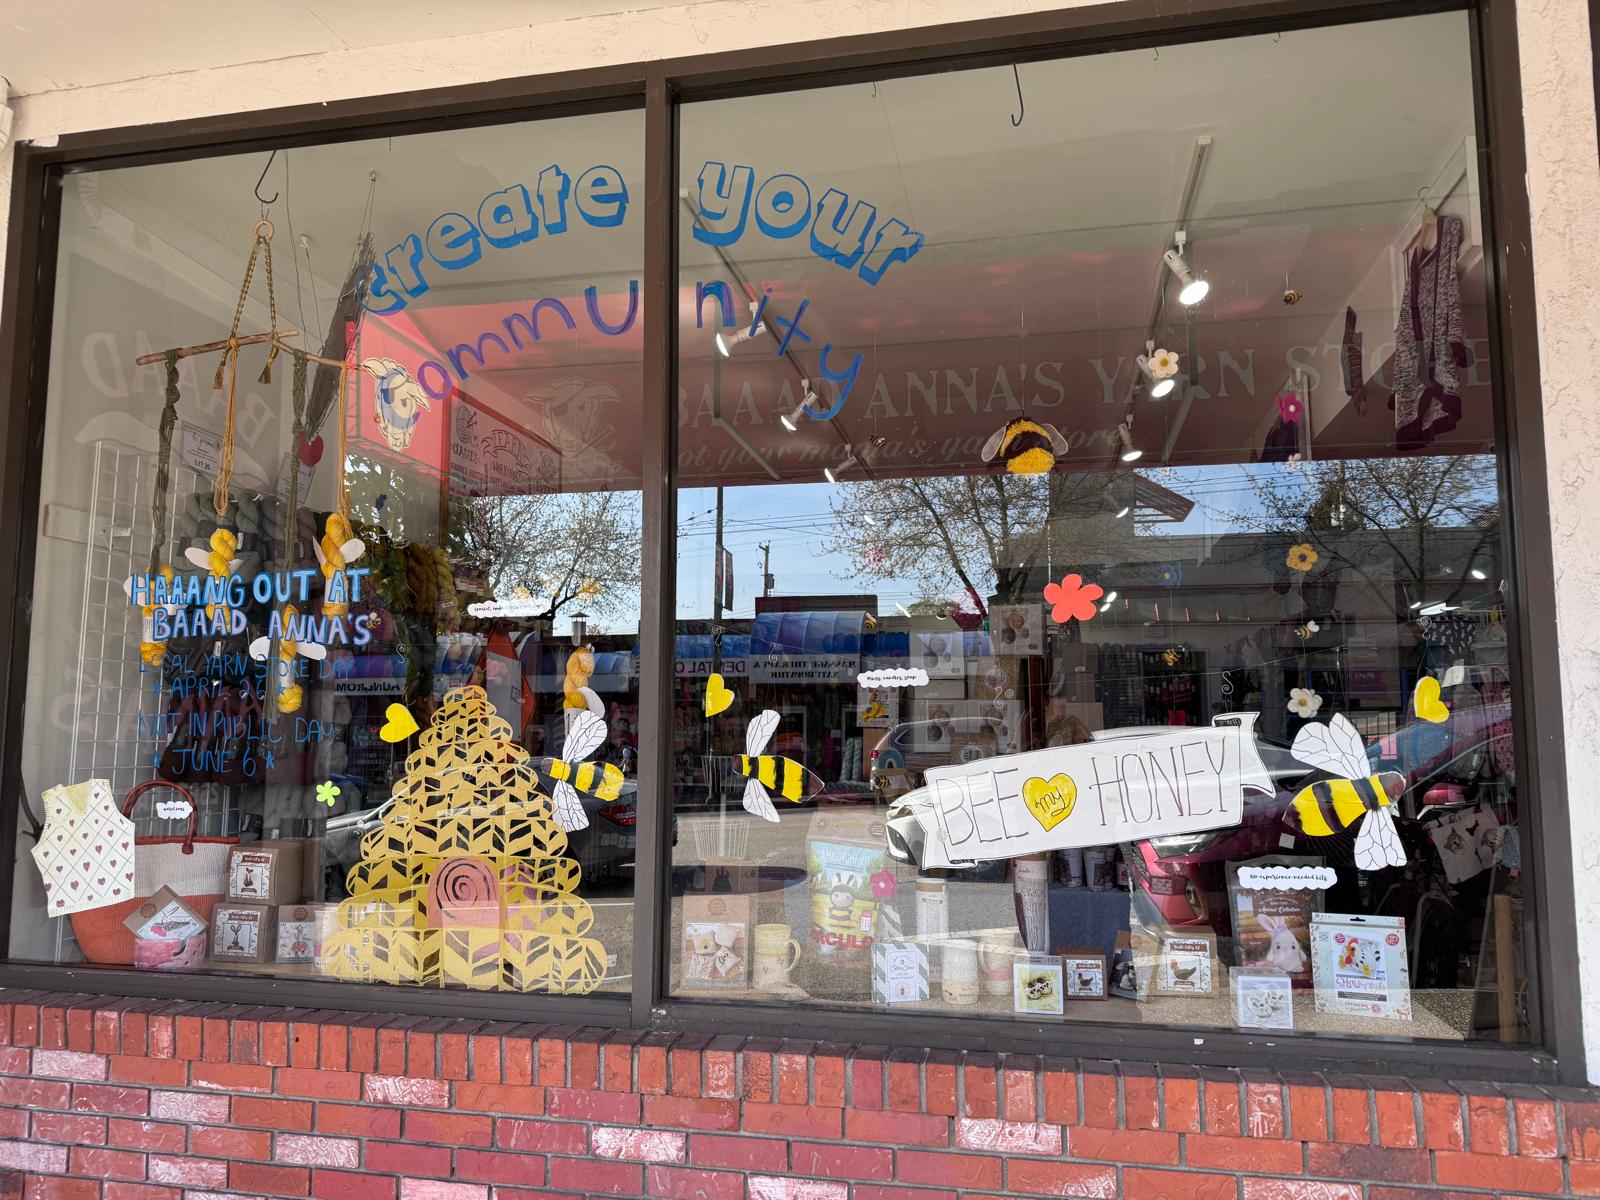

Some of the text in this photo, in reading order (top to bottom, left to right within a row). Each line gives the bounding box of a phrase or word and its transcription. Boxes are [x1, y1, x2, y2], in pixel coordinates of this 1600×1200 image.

[355, 161, 924, 316] create your
[863, 361, 1064, 423] ANNA'S
[678, 449, 709, 469] ot
[130, 567, 371, 608] HAAANG OUT AT
[152, 607, 372, 646] BAAAD ANNA'S
[139, 652, 355, 681] LOCAL YARN STORE DAY
[169, 676, 267, 700] APRIL 26
[138, 711, 182, 738] KNIT
[187, 711, 208, 739] IN
[212, 710, 282, 745] PUBLIC
[171, 749, 257, 778] JUNE 6
[937, 736, 1228, 847] BEE my HONEY
